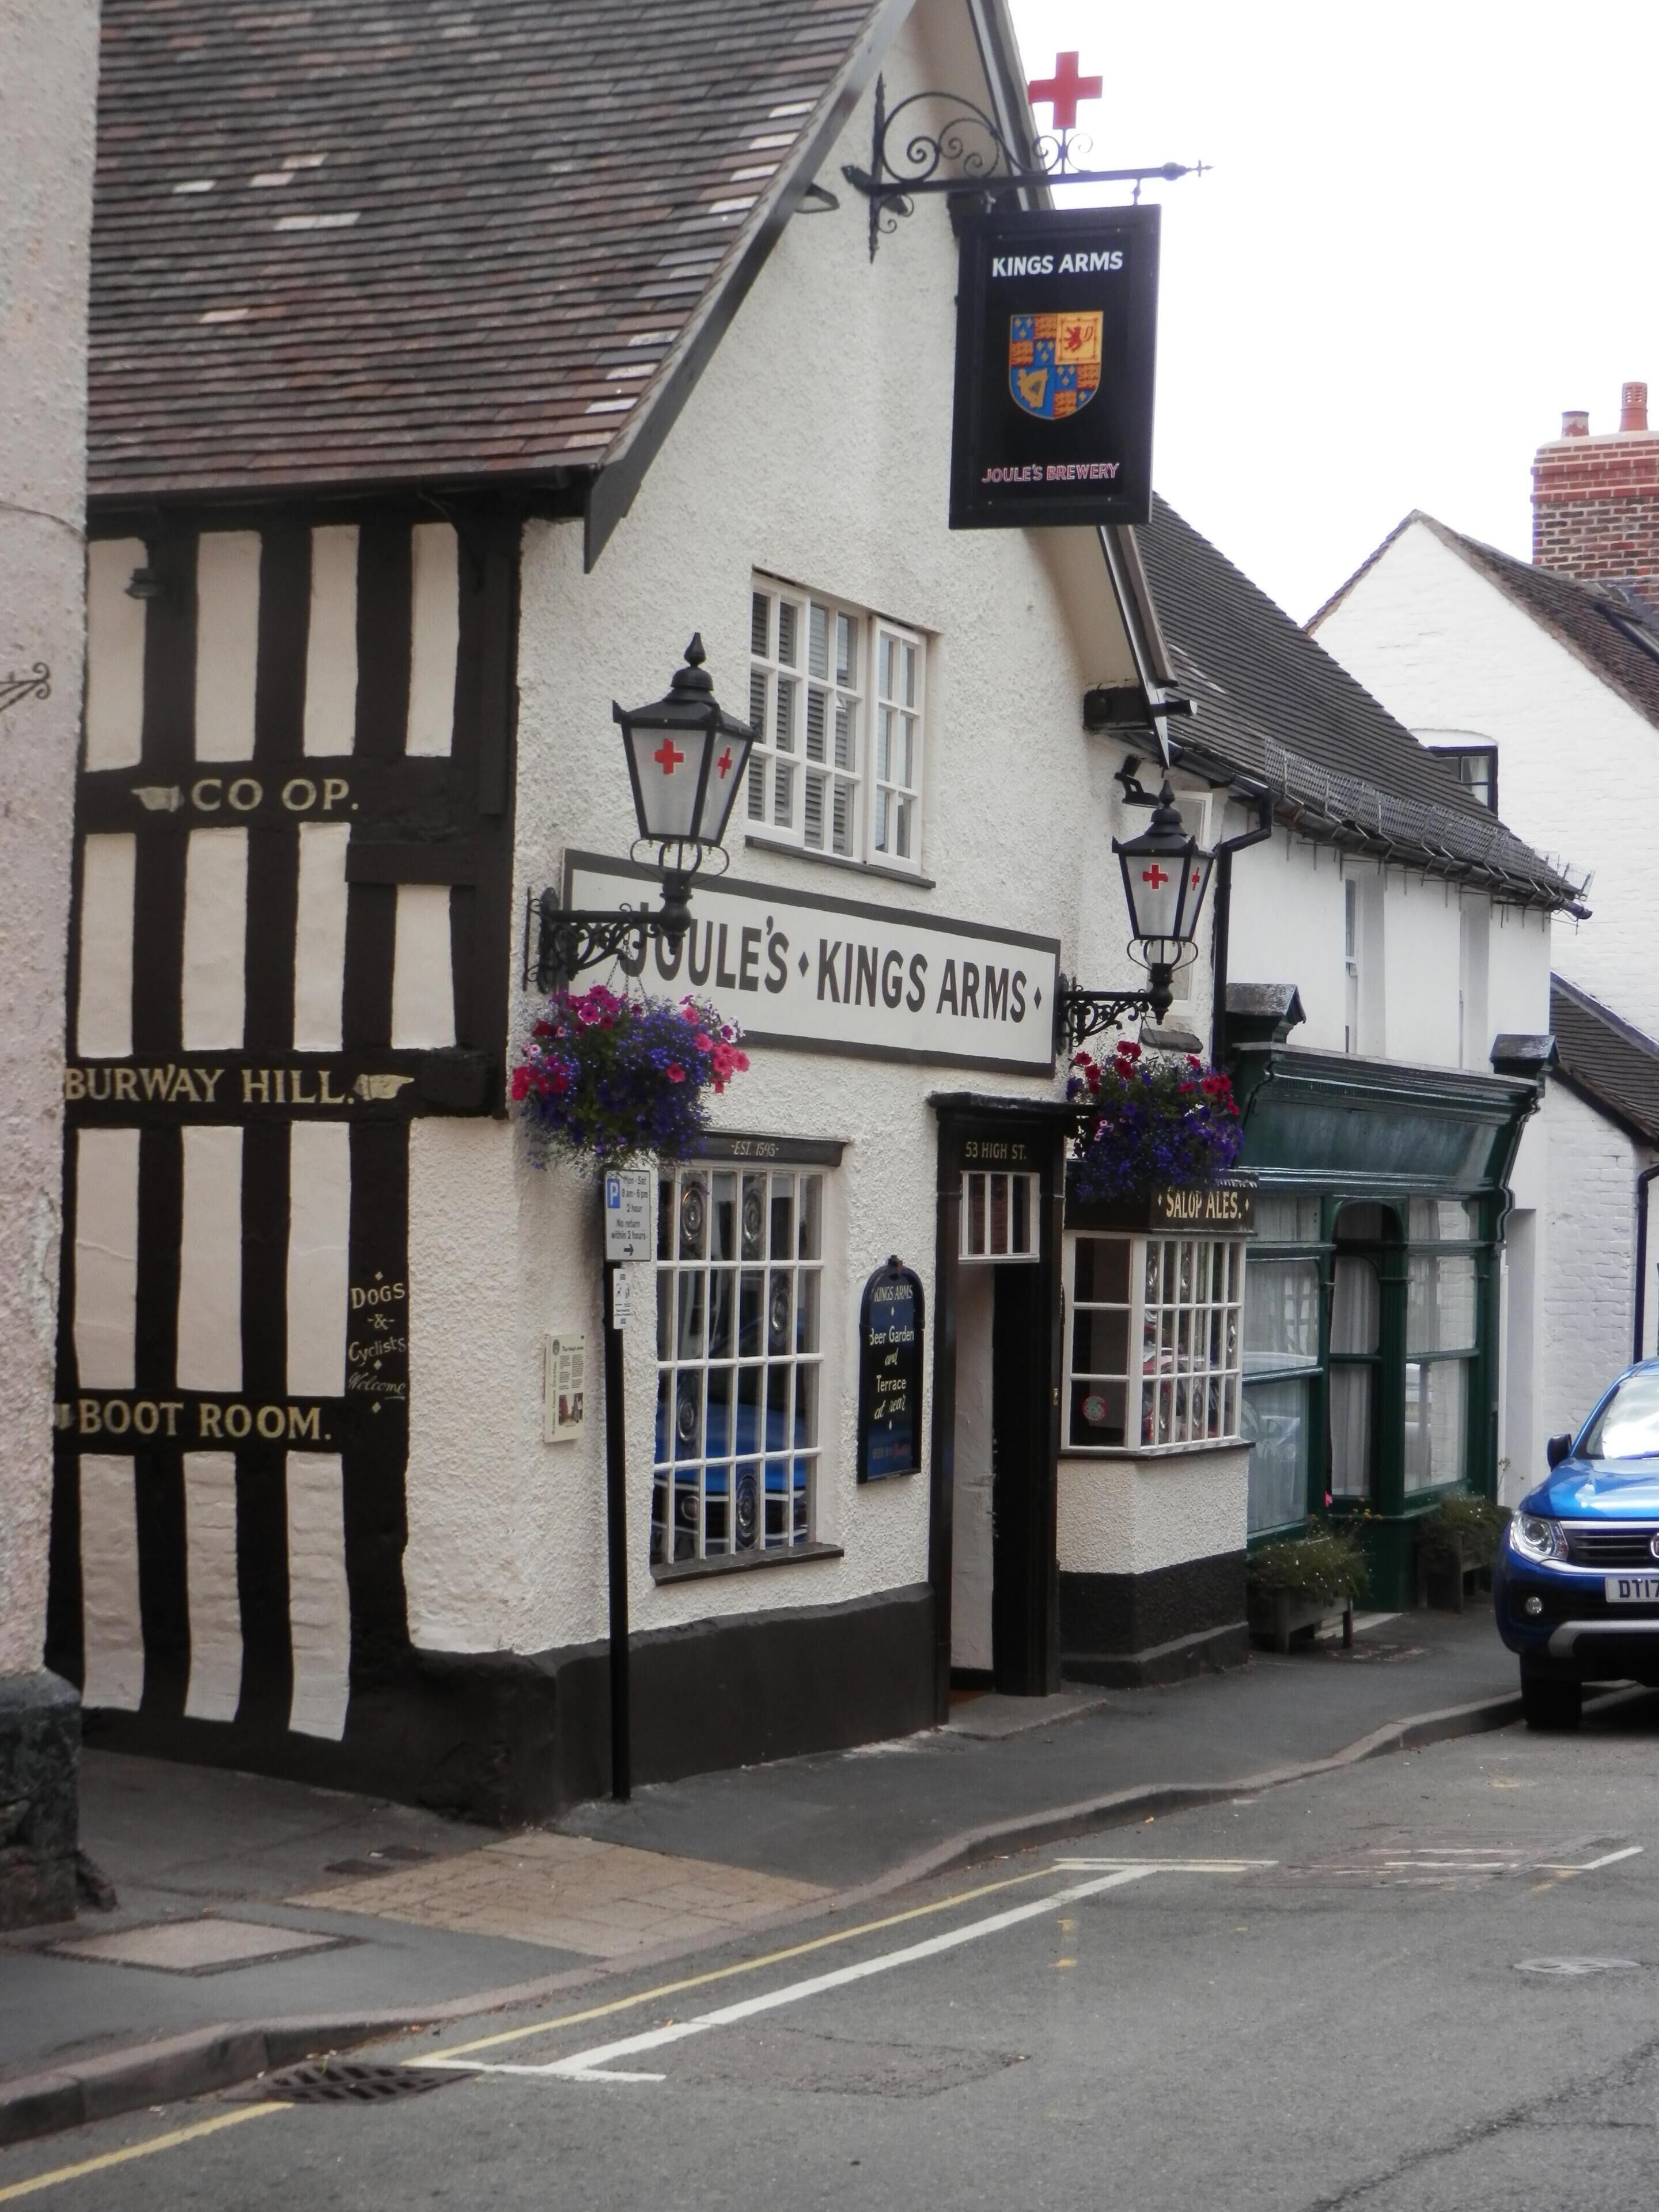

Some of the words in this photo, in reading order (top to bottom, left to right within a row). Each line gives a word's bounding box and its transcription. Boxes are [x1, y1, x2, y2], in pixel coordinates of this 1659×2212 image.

[992, 255, 1054, 277] KINGS
[1059, 251, 1123, 273] ARMS
[982, 463, 1043, 483] JOULE'S
[1047, 463, 1120, 480] BREWERY
[191, 779, 263, 810] CO
[282, 779, 358, 810] OP.
[817, 939, 927, 1012] KINGS
[936, 958, 1027, 1024] ARMS
[65, 1064, 225, 1102] BURWAY
[242, 1070, 355, 1104] HILL.
[734, 1141, 751, 1156] EST.
[756, 1142, 775, 1157] 1593
[965, 1141, 978, 1158] 53
[982, 1142, 1007, 1159] HIGH
[1012, 1144, 1027, 1160] ST.
[638, 1176, 646, 1185] Sat
[611, 1182, 619, 1206] P
[1166, 1187, 1202, 1218] SALOP
[1206, 1191, 1242, 1219] ALES.
[627, 1203, 630, 1213] 2
[616, 1218, 624, 1228] No
[625, 1219, 641, 1228] return
[611, 1230, 626, 1239] within
[628, 1230, 631, 1239] 2
[350, 1283, 406, 1309] DOGS
[874, 1286, 893, 1302] KINGS
[894, 1285, 913, 1300] ARMS
[889, 1325, 914, 1343] Garden
[349, 1336, 406, 1366] Cyclists
[885, 1347, 899, 1366] and
[348, 1372, 406, 1394] Welcome
[876, 1374, 907, 1392] Terrace
[874, 1399, 886, 1419] at
[889, 1393, 906, 1411] rear
[78, 1399, 184, 1435] BOOT
[199, 1403, 331, 1440] ROOM.
